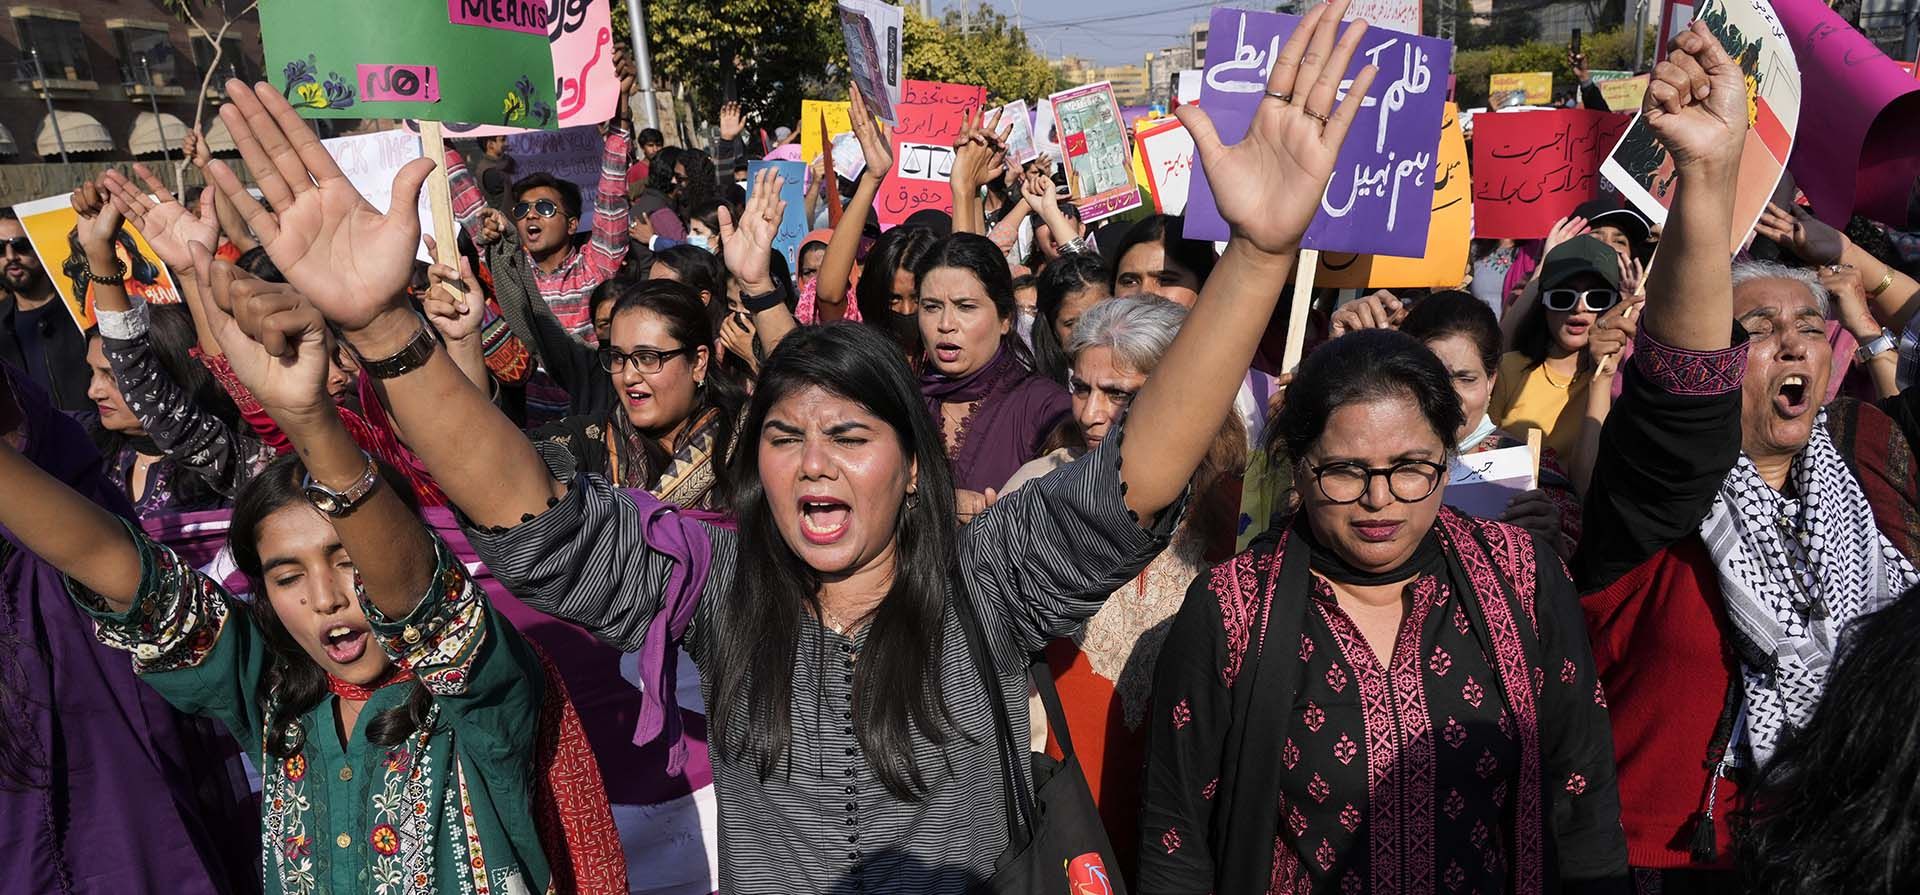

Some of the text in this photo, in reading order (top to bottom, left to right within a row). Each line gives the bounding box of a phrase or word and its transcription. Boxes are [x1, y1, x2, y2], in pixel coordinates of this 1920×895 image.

[460, 0, 547, 29] MEANS
[367, 66, 431, 99] NO!
[1376, 42, 1431, 154] ظلم
[1491, 123, 1572, 165] اجرت
[885, 186, 942, 214] حقوق
[1321, 151, 1430, 232] ہم نہیں
[1456, 461, 1494, 482] جہیز
